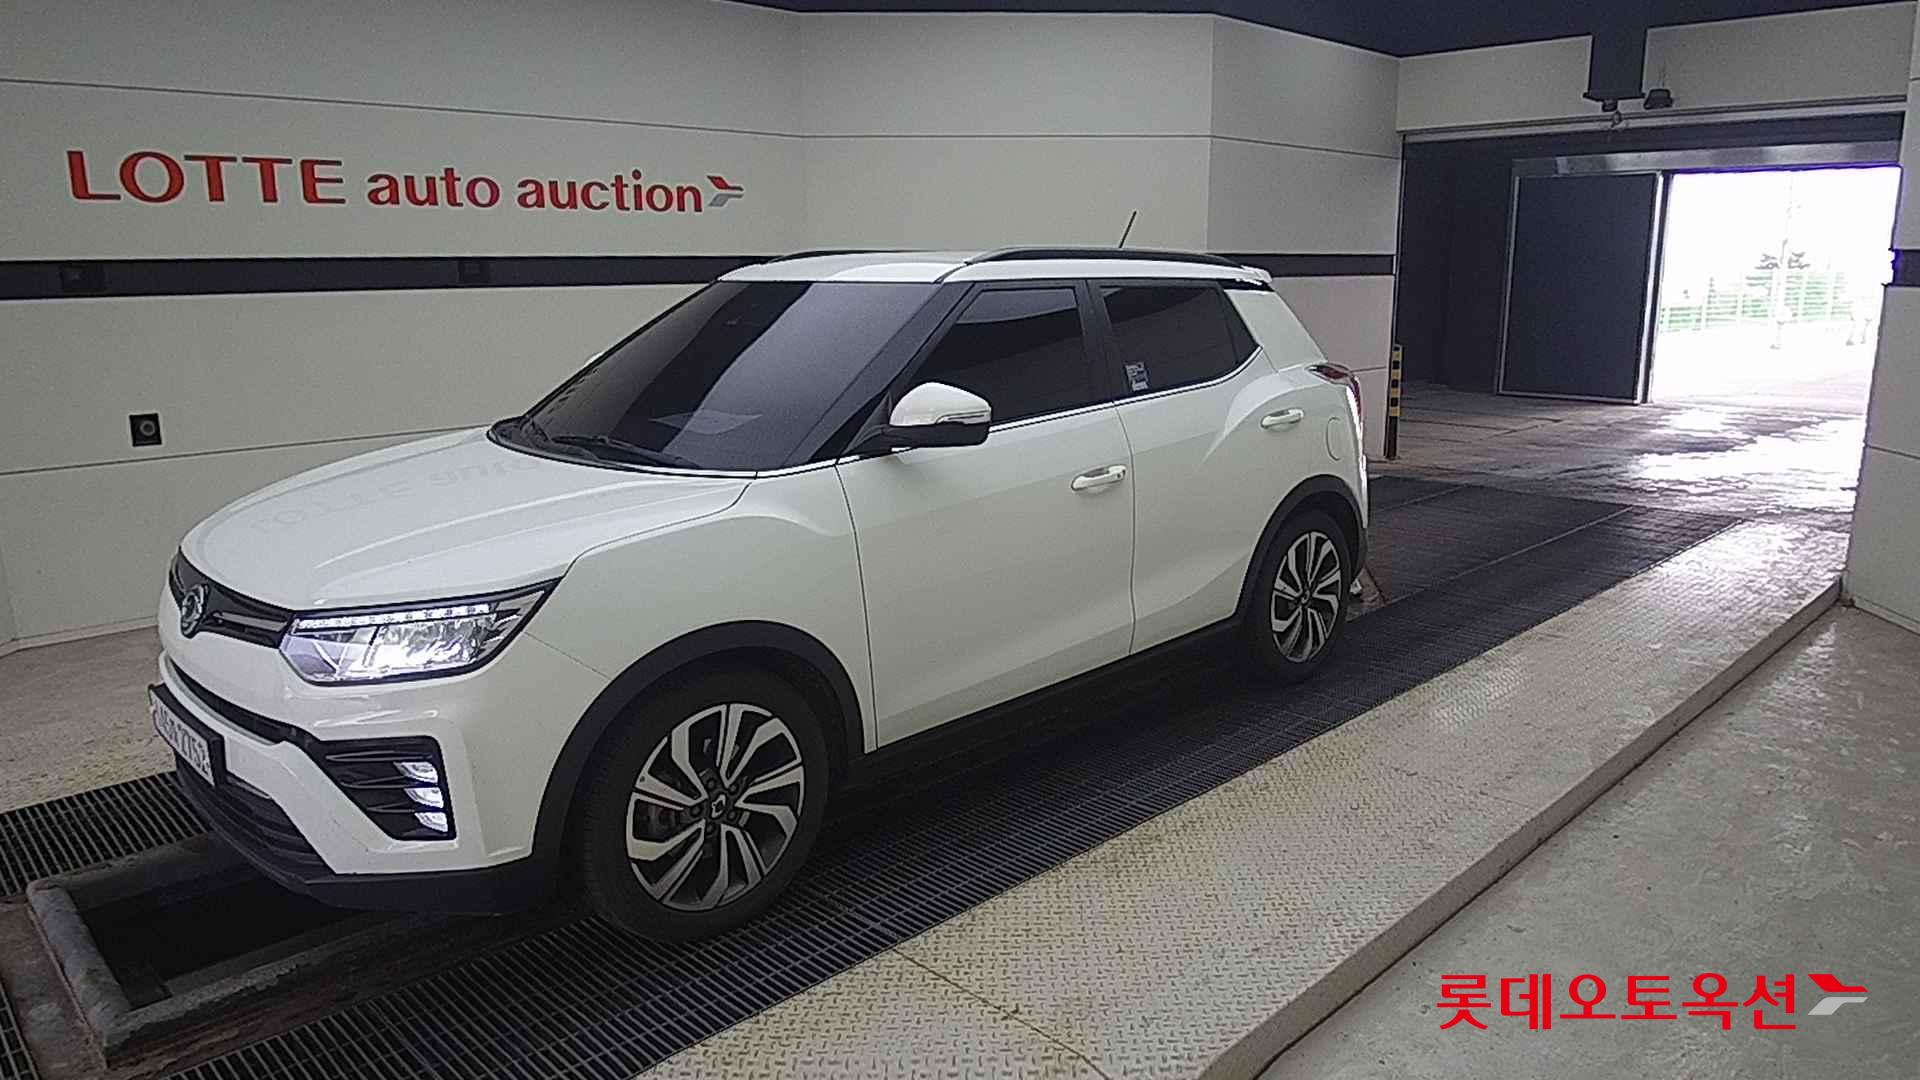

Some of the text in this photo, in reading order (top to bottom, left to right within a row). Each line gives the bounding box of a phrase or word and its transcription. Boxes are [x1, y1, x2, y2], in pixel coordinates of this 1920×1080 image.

[66, 150, 703, 213] LOTTE auto auction
